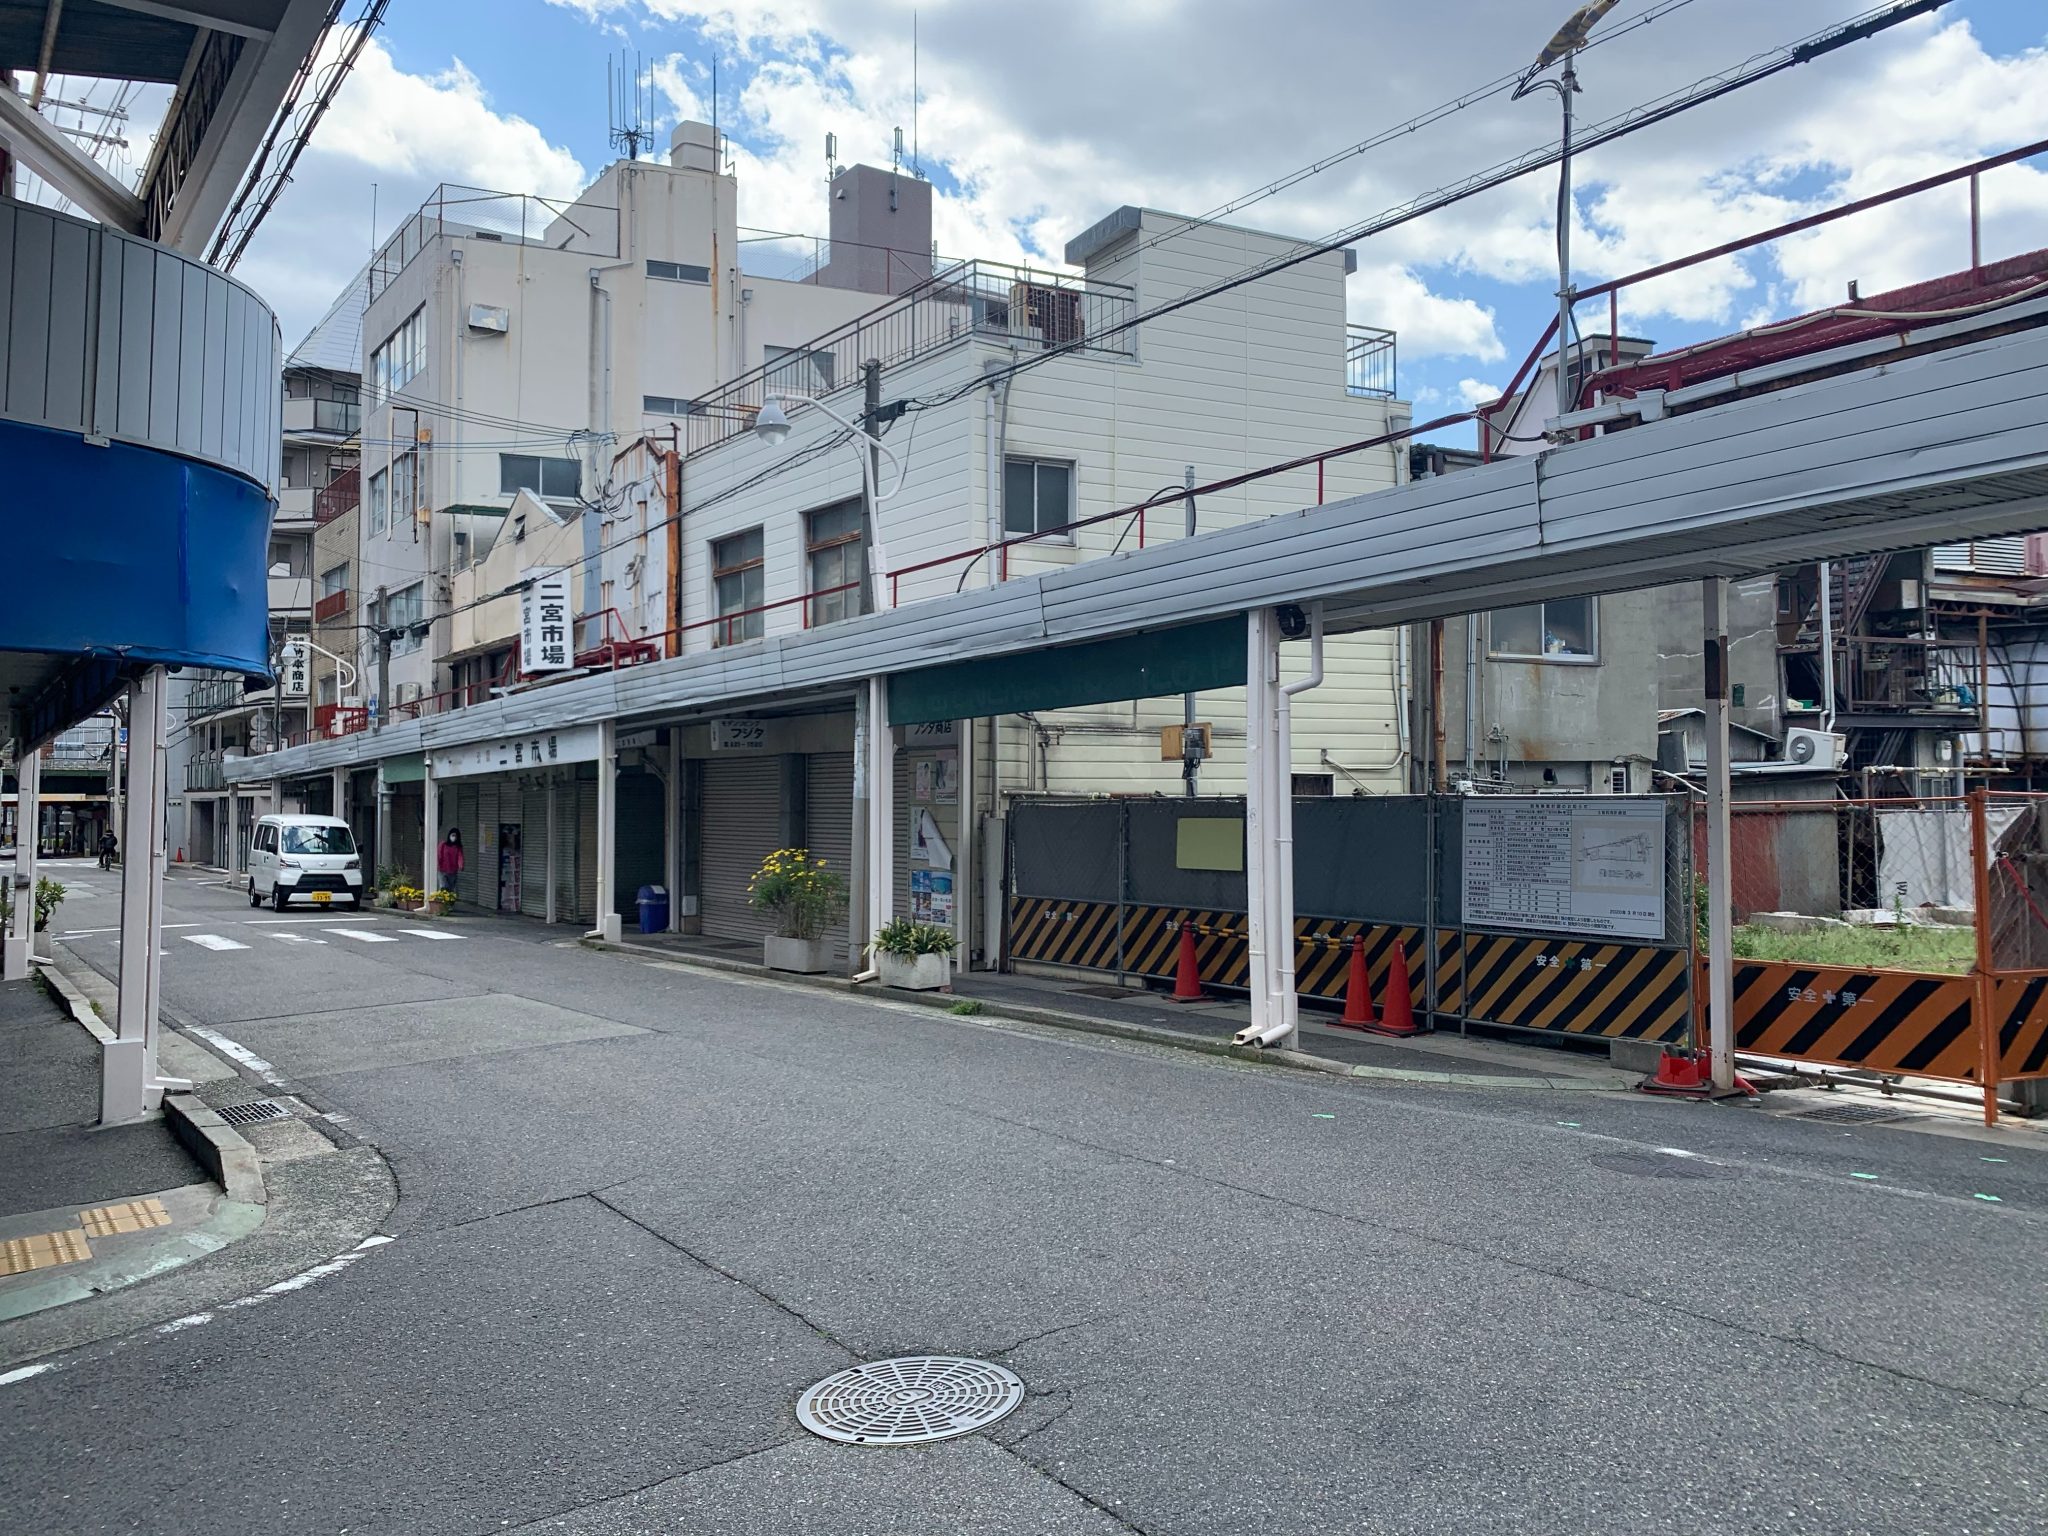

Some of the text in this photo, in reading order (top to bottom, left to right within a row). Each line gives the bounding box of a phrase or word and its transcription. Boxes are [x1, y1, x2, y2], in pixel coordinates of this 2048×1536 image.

[540, 584, 566, 665] 二宮市場
[291, 648, 305, 692] 竹本商店
[730, 727, 764, 740] フジタ
[499, 735, 558, 765] 二宮市場
[1535, 954, 1608, 972] 安全 第一
[1788, 987, 1874, 1007] 安全 第一
